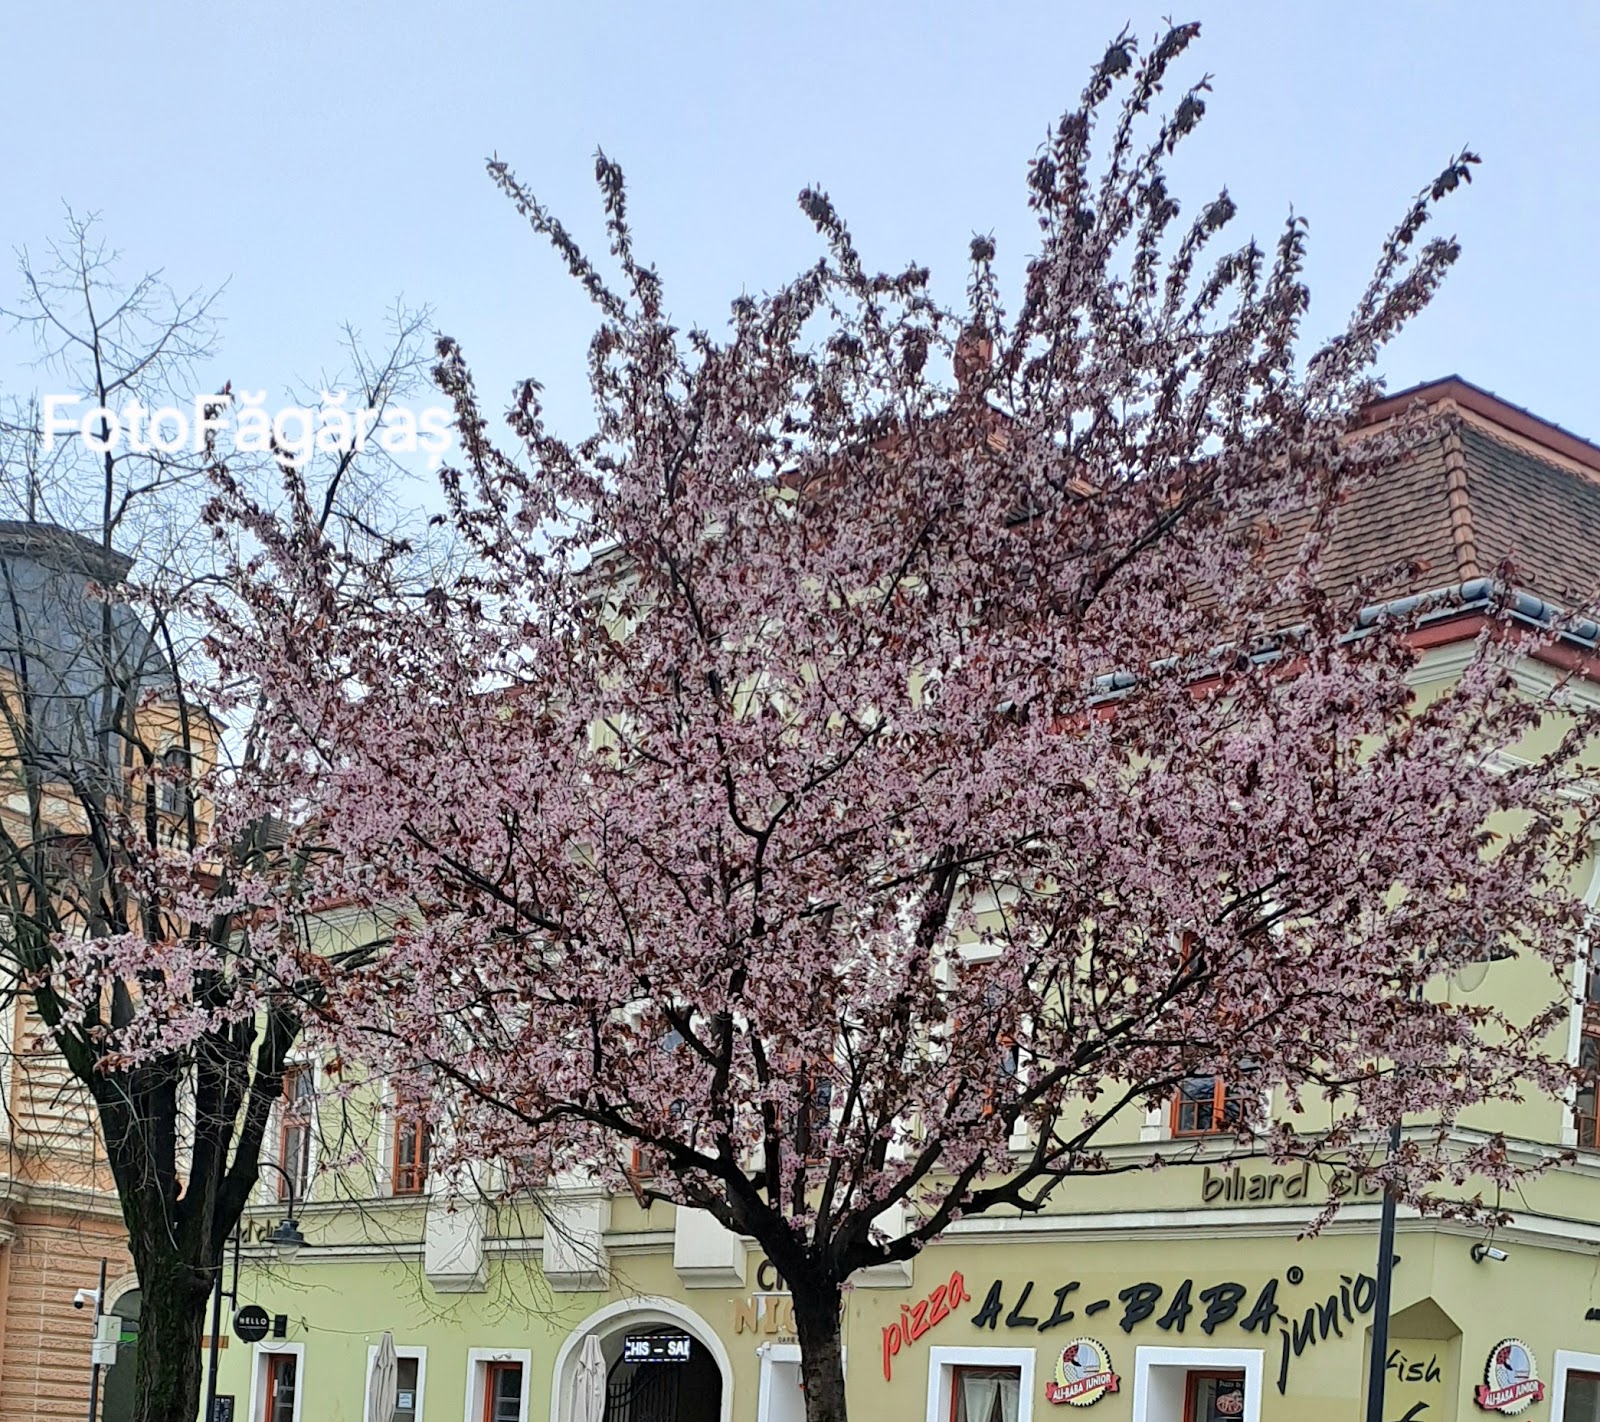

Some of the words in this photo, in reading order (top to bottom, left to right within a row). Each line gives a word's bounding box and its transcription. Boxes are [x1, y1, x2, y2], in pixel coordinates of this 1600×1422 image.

[1202, 1162, 1311, 1201] biliard
[239, 1317, 267, 1325] HELLO
[882, 1270, 971, 1382] pizza
[971, 1279, 1279, 1335] ALI-BABA
[1276, 1254, 1401, 1395] junio
[1086, 1374, 1111, 1390] JUNIOR
[1515, 1380, 1539, 1401] JUNIOR
